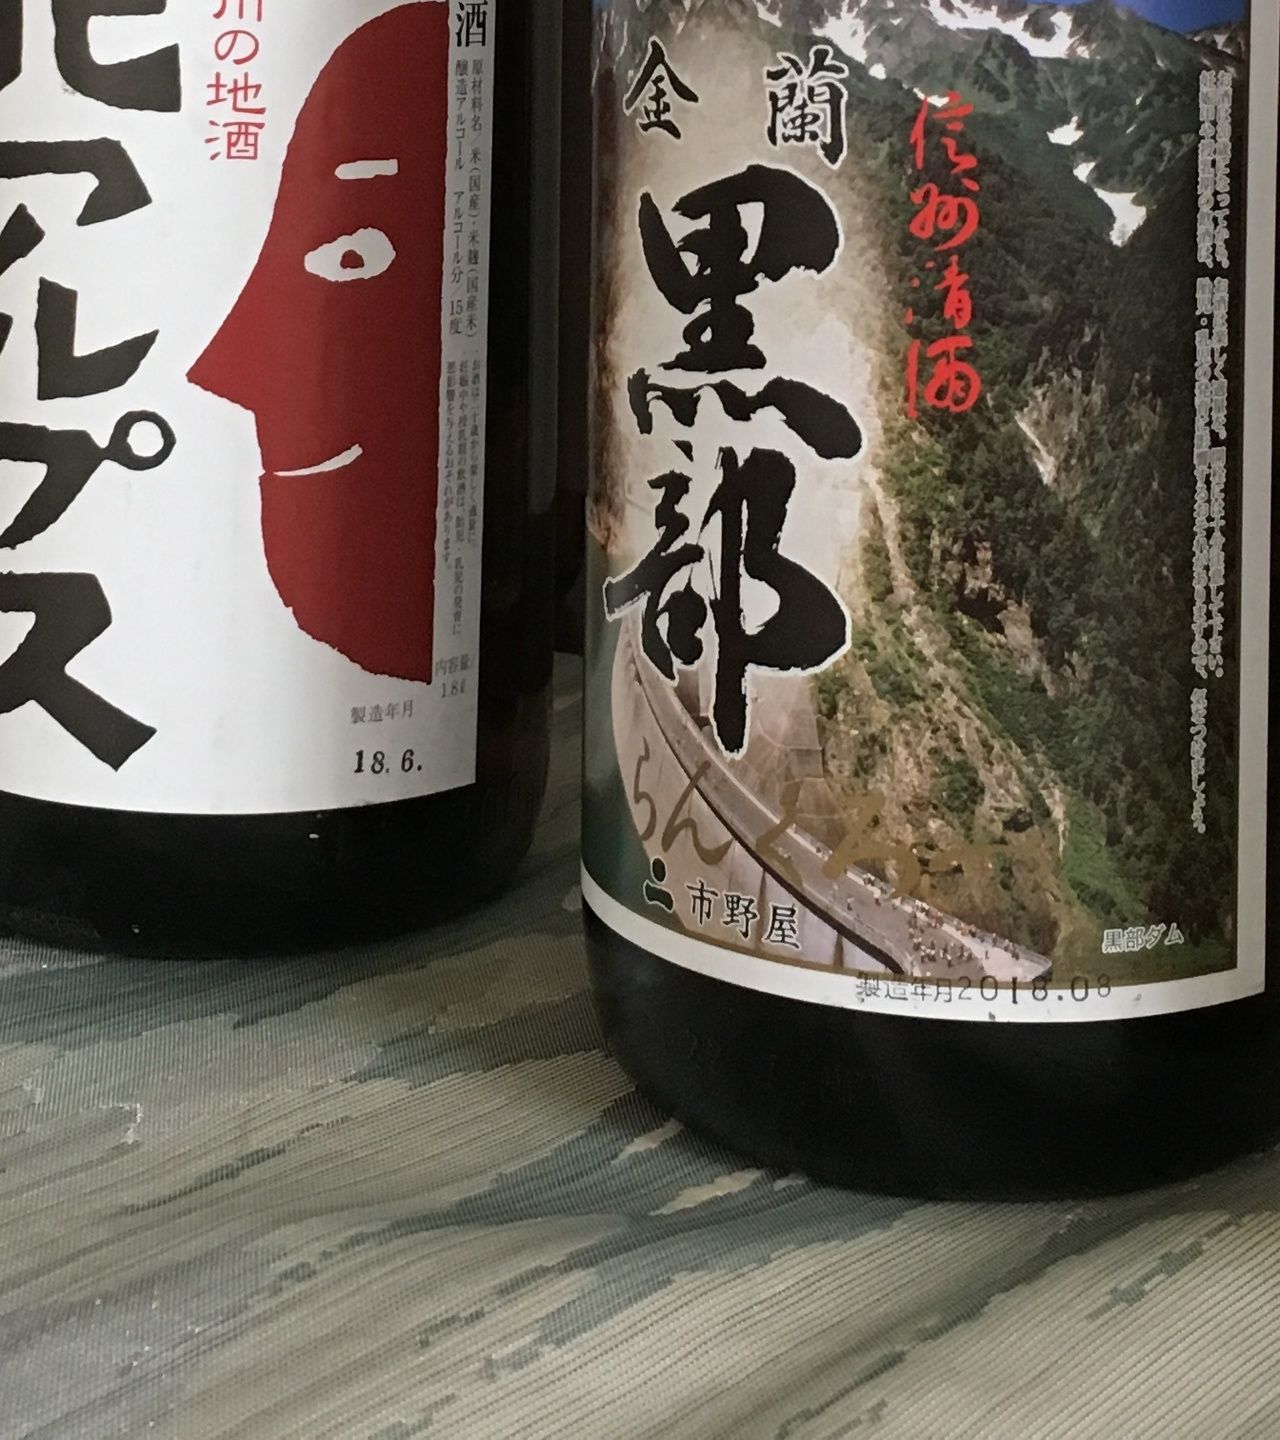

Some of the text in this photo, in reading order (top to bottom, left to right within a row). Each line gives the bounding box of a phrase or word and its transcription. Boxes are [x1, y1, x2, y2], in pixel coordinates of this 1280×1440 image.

[604, 163, 863, 757] 黒部
[350, 699, 415, 725] 製造年月
[1101, 922, 1185, 955] 黒部ダム
